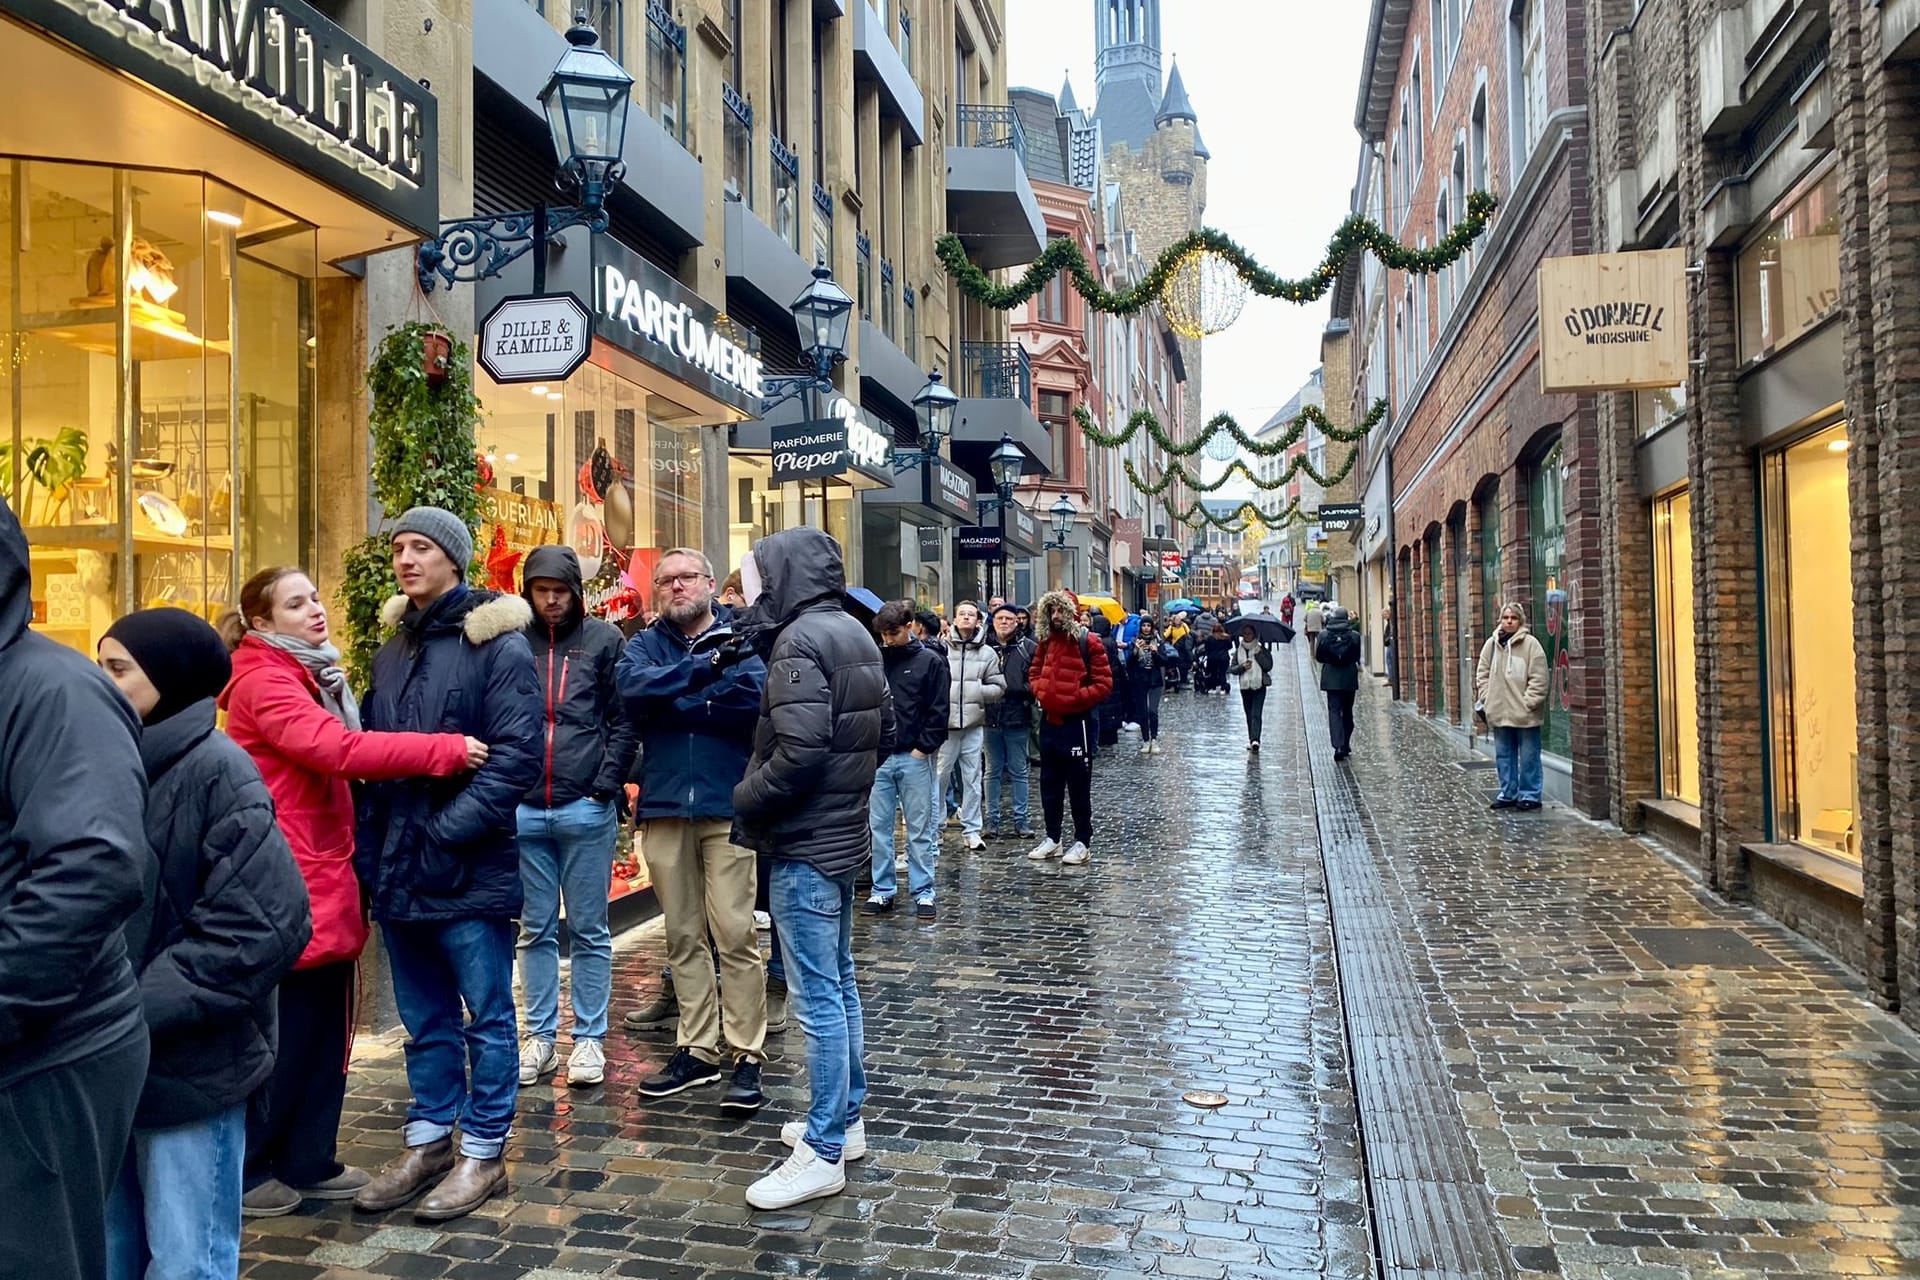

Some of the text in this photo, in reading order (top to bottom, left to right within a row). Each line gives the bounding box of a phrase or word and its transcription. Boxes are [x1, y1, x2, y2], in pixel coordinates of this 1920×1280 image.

[501, 318, 570, 338] DILLE &
[603, 264, 764, 399] PARFÜMERIE
[1586, 330, 1651, 345] MOONSHINE
[495, 336, 574, 356] KAMILLE
[773, 432, 843, 449] PARFÜMERIE
[773, 450, 843, 472] Pieper
[486, 497, 557, 530] GUERLAIN
[1325, 519, 1349, 530] mey
